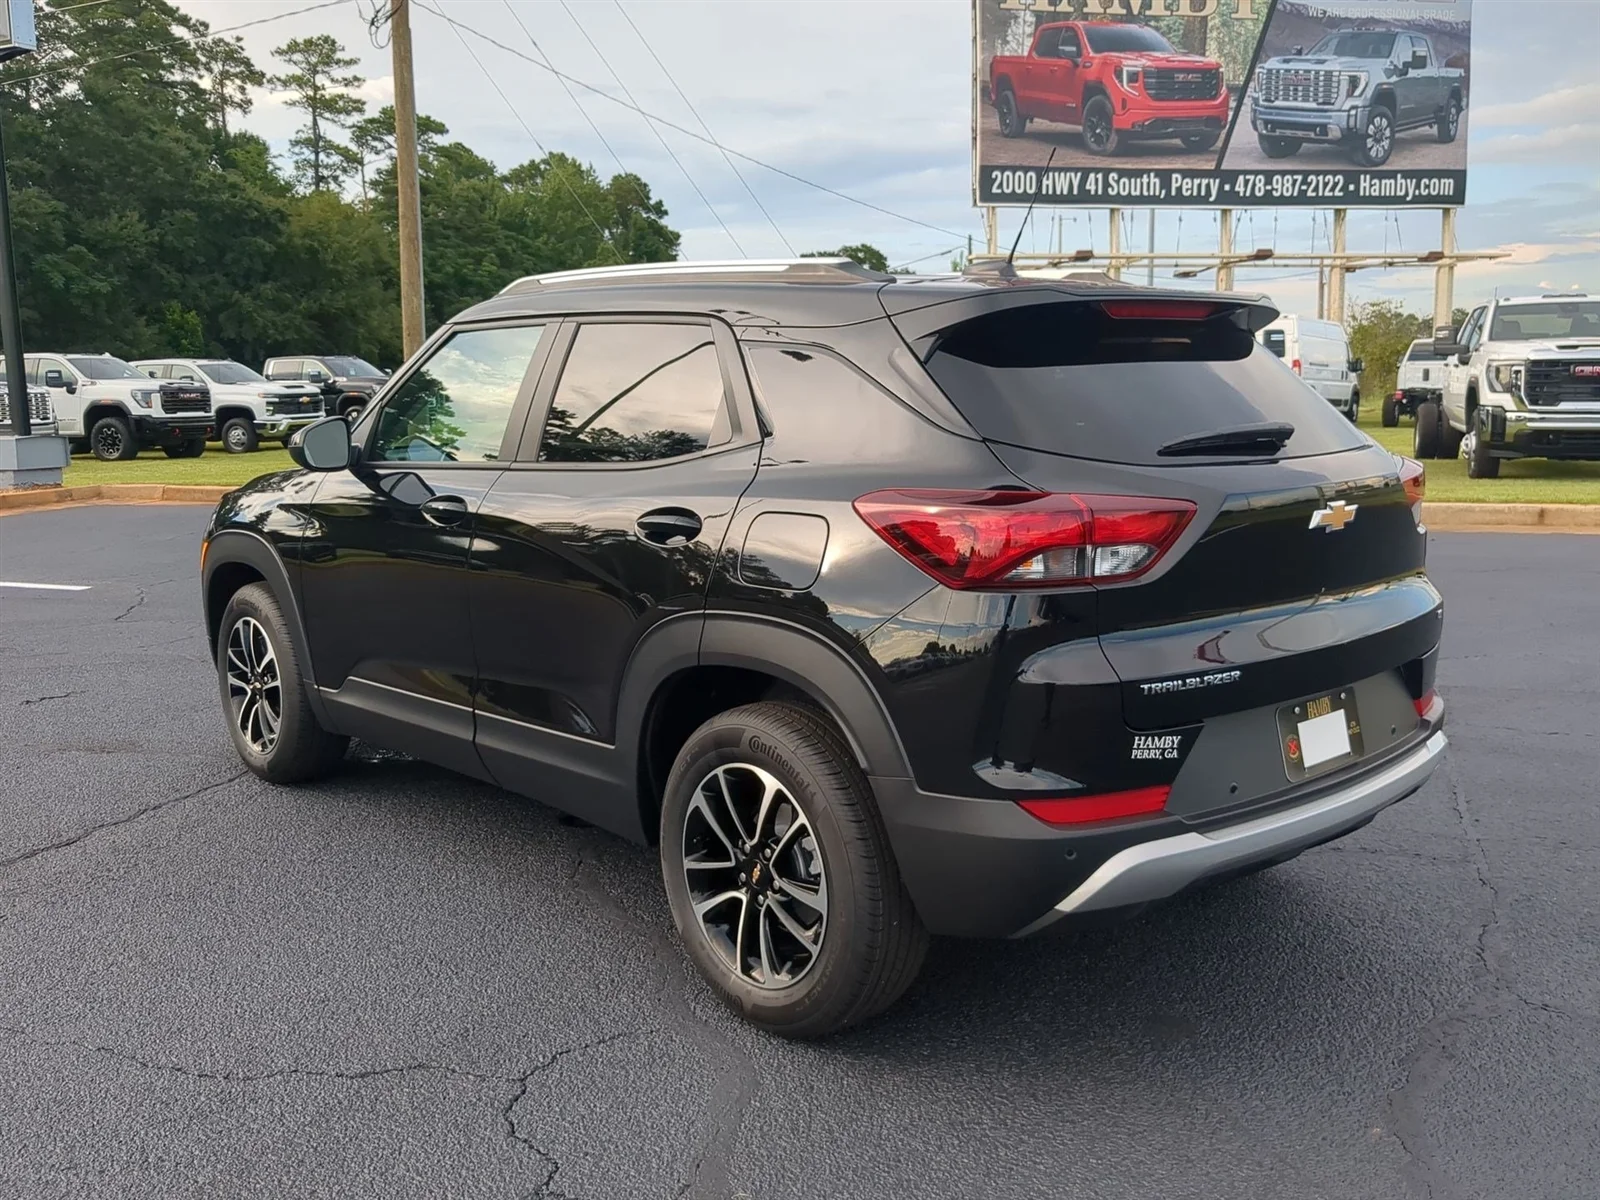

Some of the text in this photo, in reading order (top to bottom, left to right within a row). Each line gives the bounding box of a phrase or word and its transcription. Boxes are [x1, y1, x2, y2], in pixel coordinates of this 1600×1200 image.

[991, 170, 1455, 202] 2000 HWY 41 South, Perry 478-987-2122 Hamby.com
[1139, 670, 1242, 695] TRAILBLAZER
[1307, 696, 1332, 719] HAMBY
[1131, 749, 1178, 760] PERRY, GA
[1132, 736, 1181, 749] HAMBY
[748, 735, 811, 793] Continental
